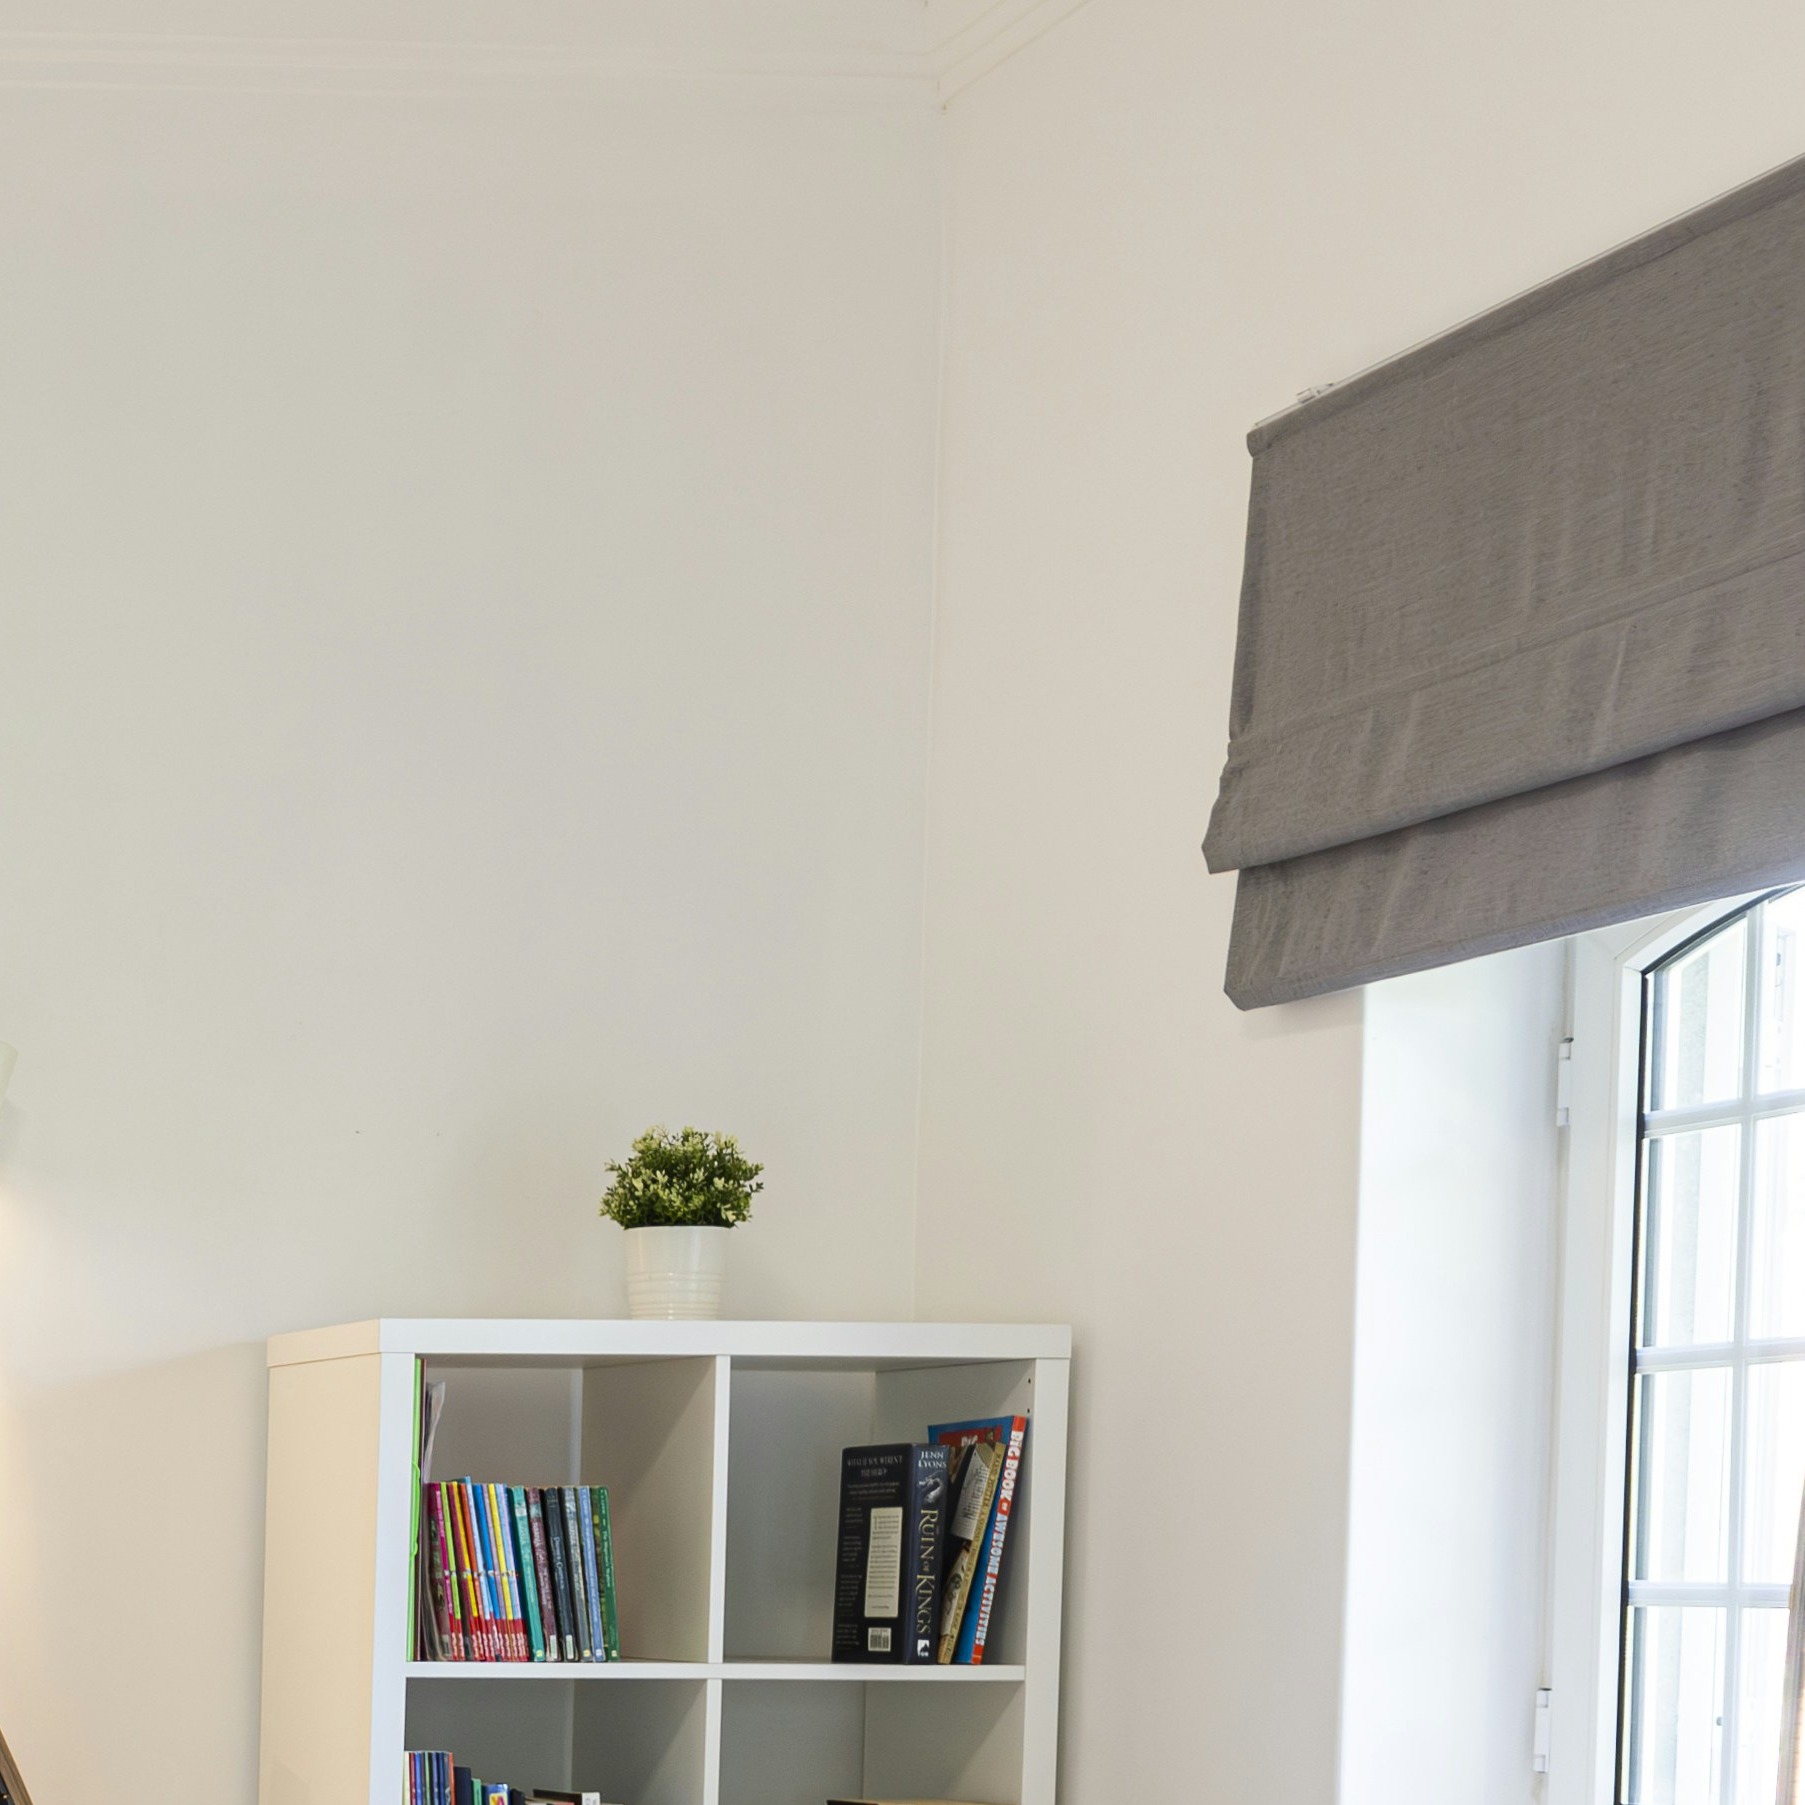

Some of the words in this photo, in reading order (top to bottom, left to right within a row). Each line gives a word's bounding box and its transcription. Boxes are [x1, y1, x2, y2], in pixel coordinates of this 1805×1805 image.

[918, 1459, 948, 1469] LYONS
[920, 1450, 945, 1460] JENN
[999, 1459, 1019, 1500] BOOK
[918, 1509, 939, 1560] RUIN
[987, 1514, 1009, 1574] AWESOME
[916, 1574, 936, 1634] KINGS
[975, 1575, 997, 1646] ACTIVITIES
